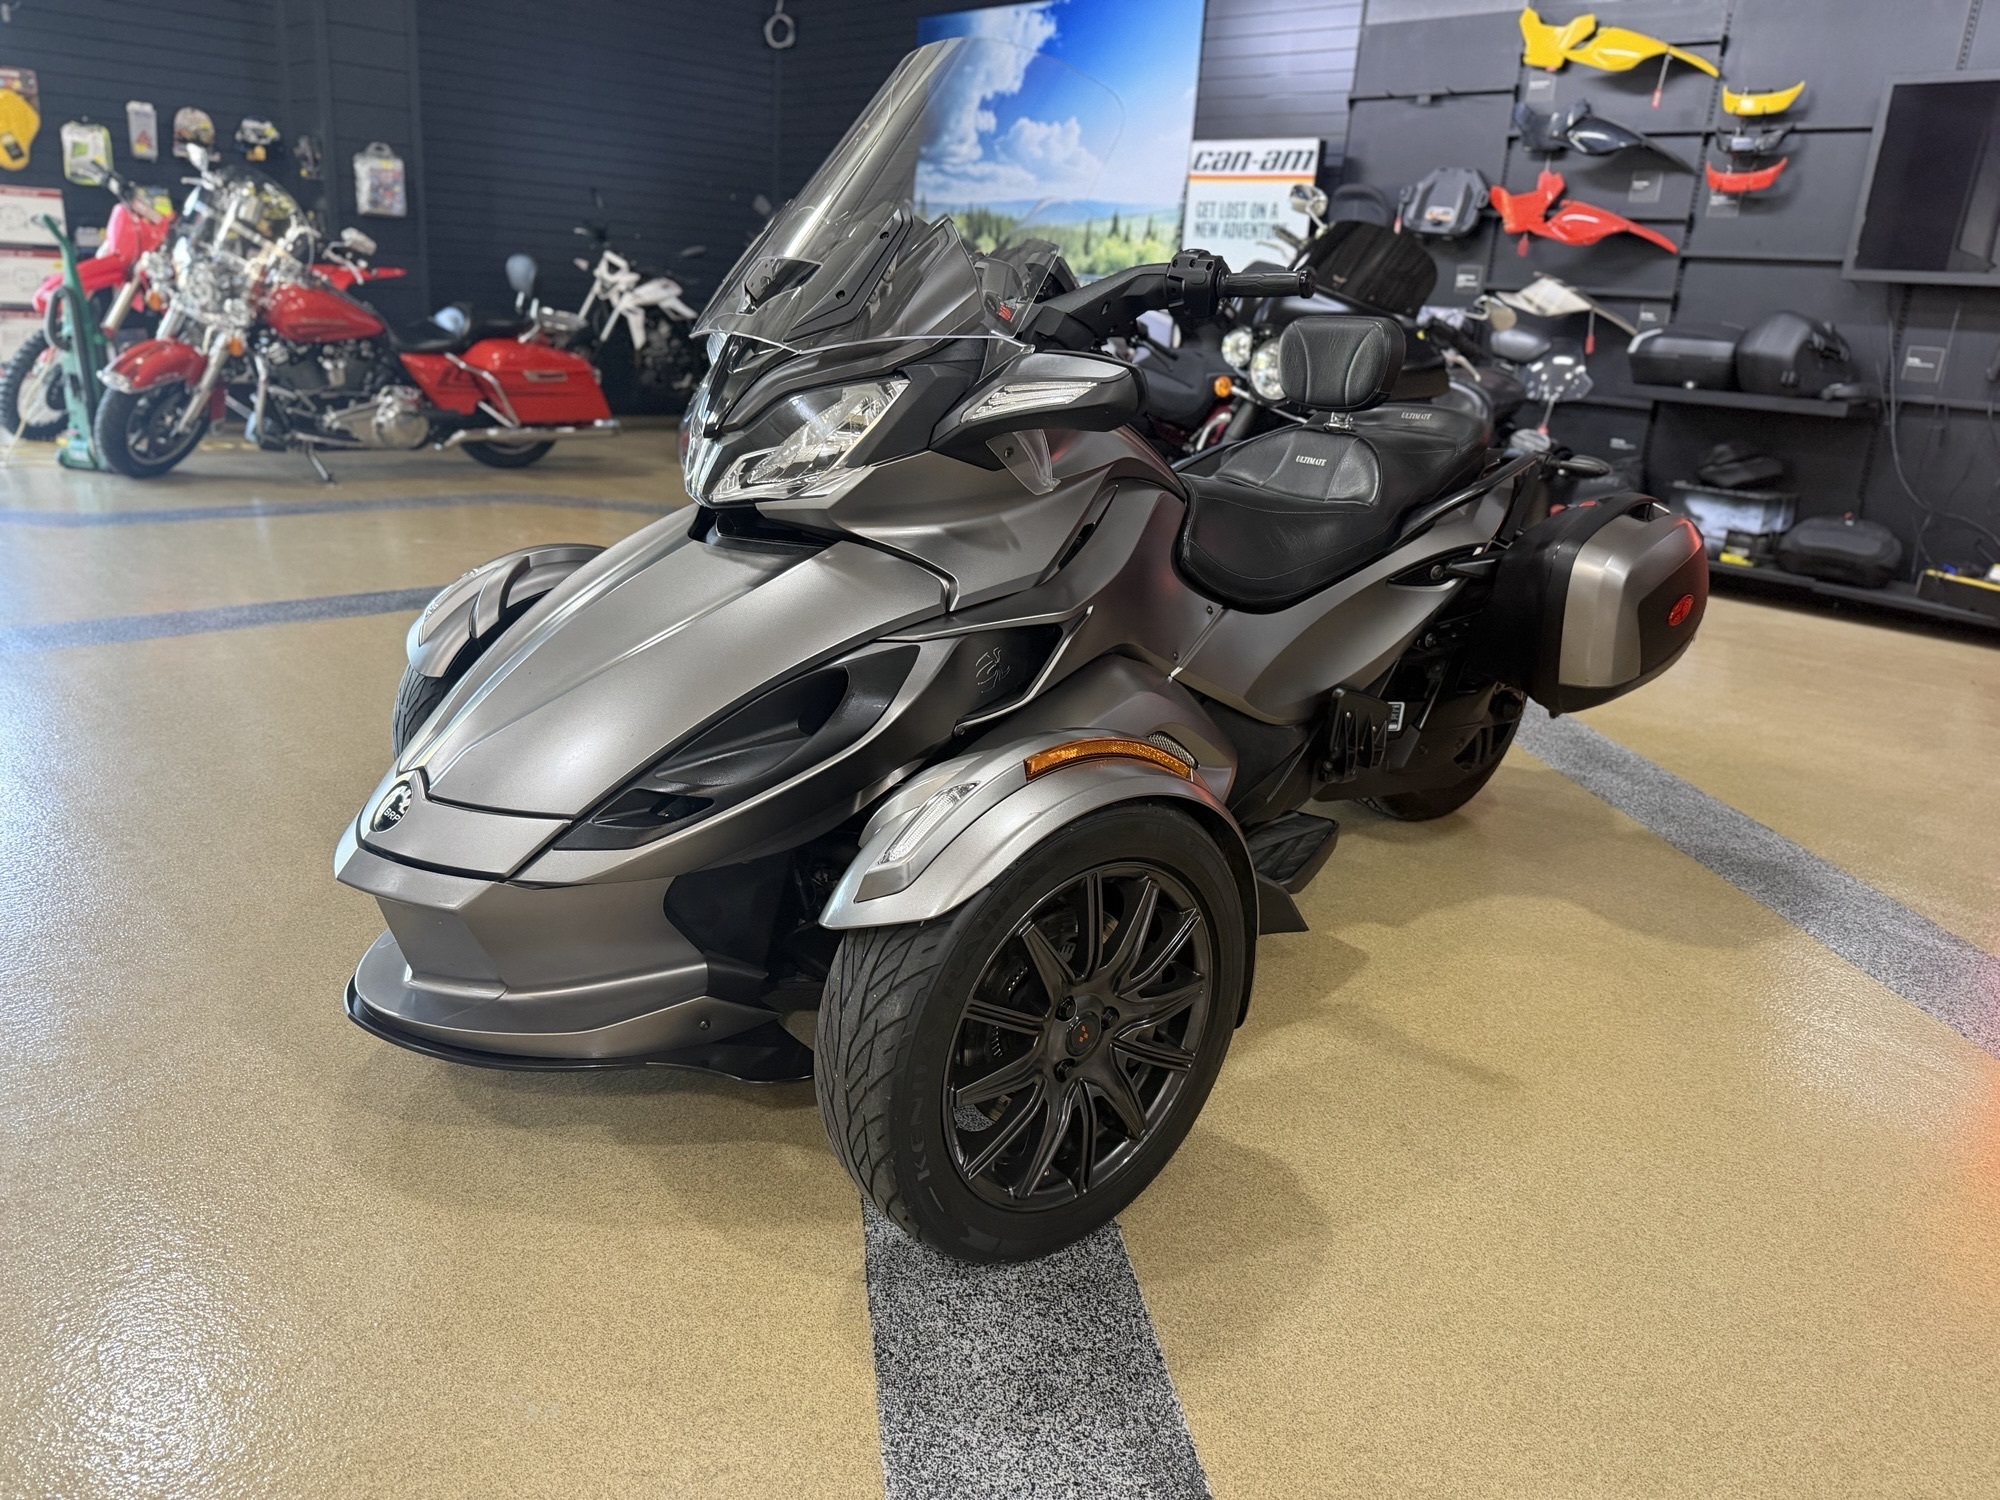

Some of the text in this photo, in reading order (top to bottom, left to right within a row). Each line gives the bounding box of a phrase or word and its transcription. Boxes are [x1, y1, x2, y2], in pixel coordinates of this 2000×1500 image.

[1193, 149, 1315, 171] can-am
[1195, 201, 1279, 219] GET LOST ON A
[1194, 221, 1287, 240] NEW ADVENTU
[1401, 411, 1432, 420] ULTIMATE
[1295, 455, 1327, 467] ULTIMATE
[383, 807, 401, 821] BRP
